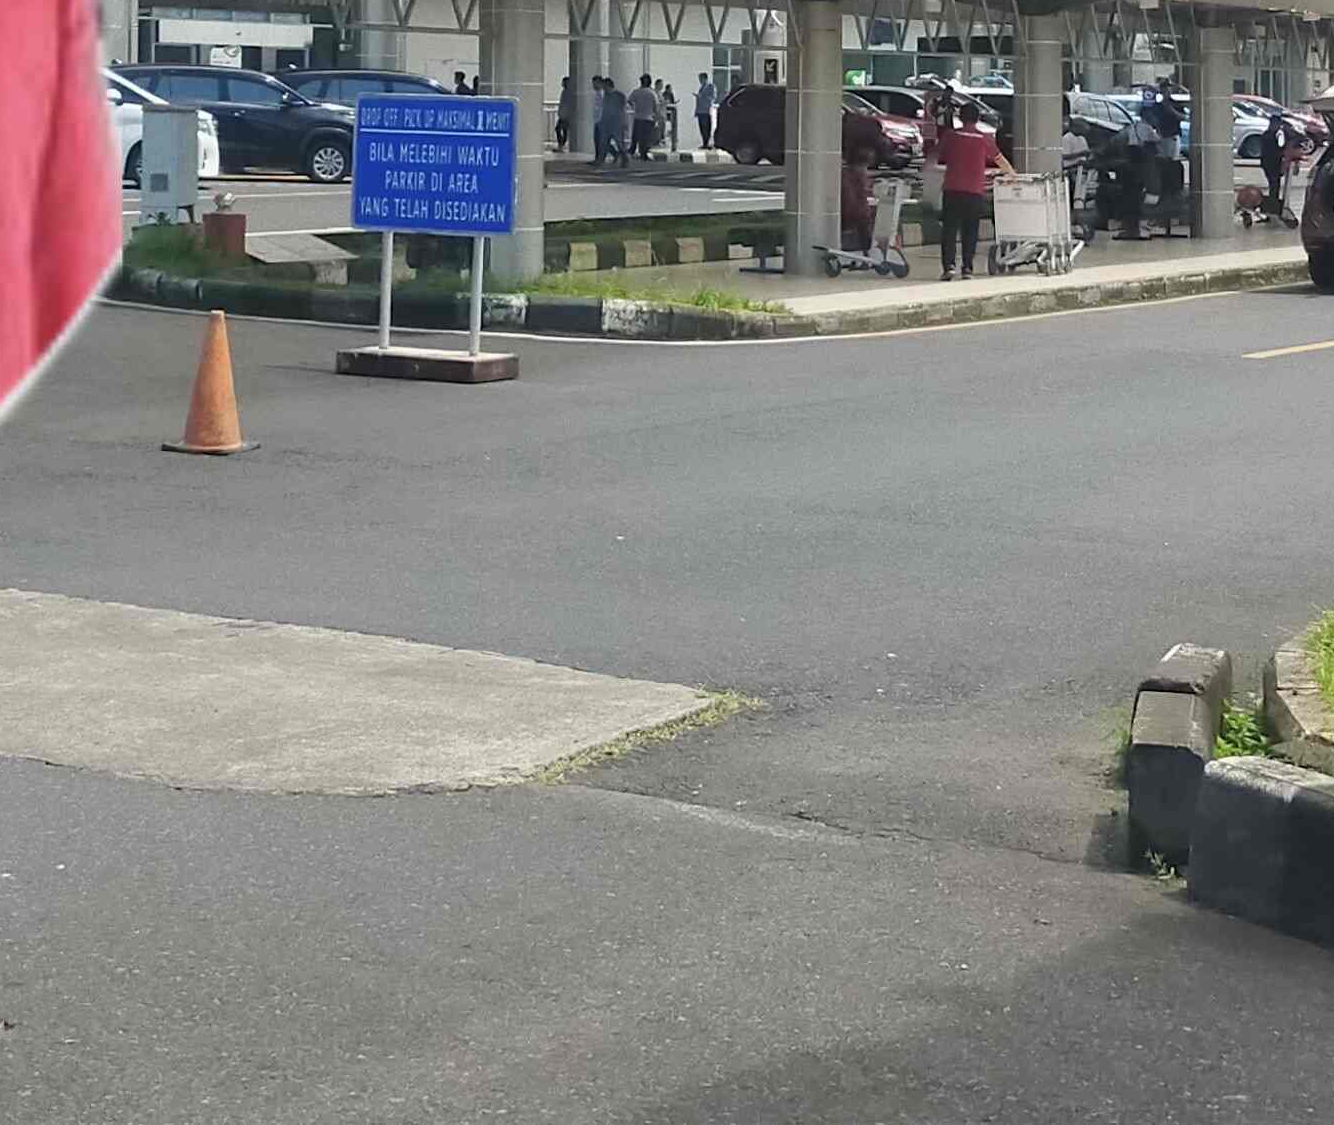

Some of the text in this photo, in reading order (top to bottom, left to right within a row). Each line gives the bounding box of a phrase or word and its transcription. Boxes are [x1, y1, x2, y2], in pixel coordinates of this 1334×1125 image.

[361, 107, 381, 125] DROP
[383, 107, 398, 126] OFF
[369, 142, 500, 166] BILA MELEBIHI WAKTU
[385, 170, 478, 193] PARKIR DI AREA
[359, 196, 506, 223] YANG TELAH DISEDIAKAN
